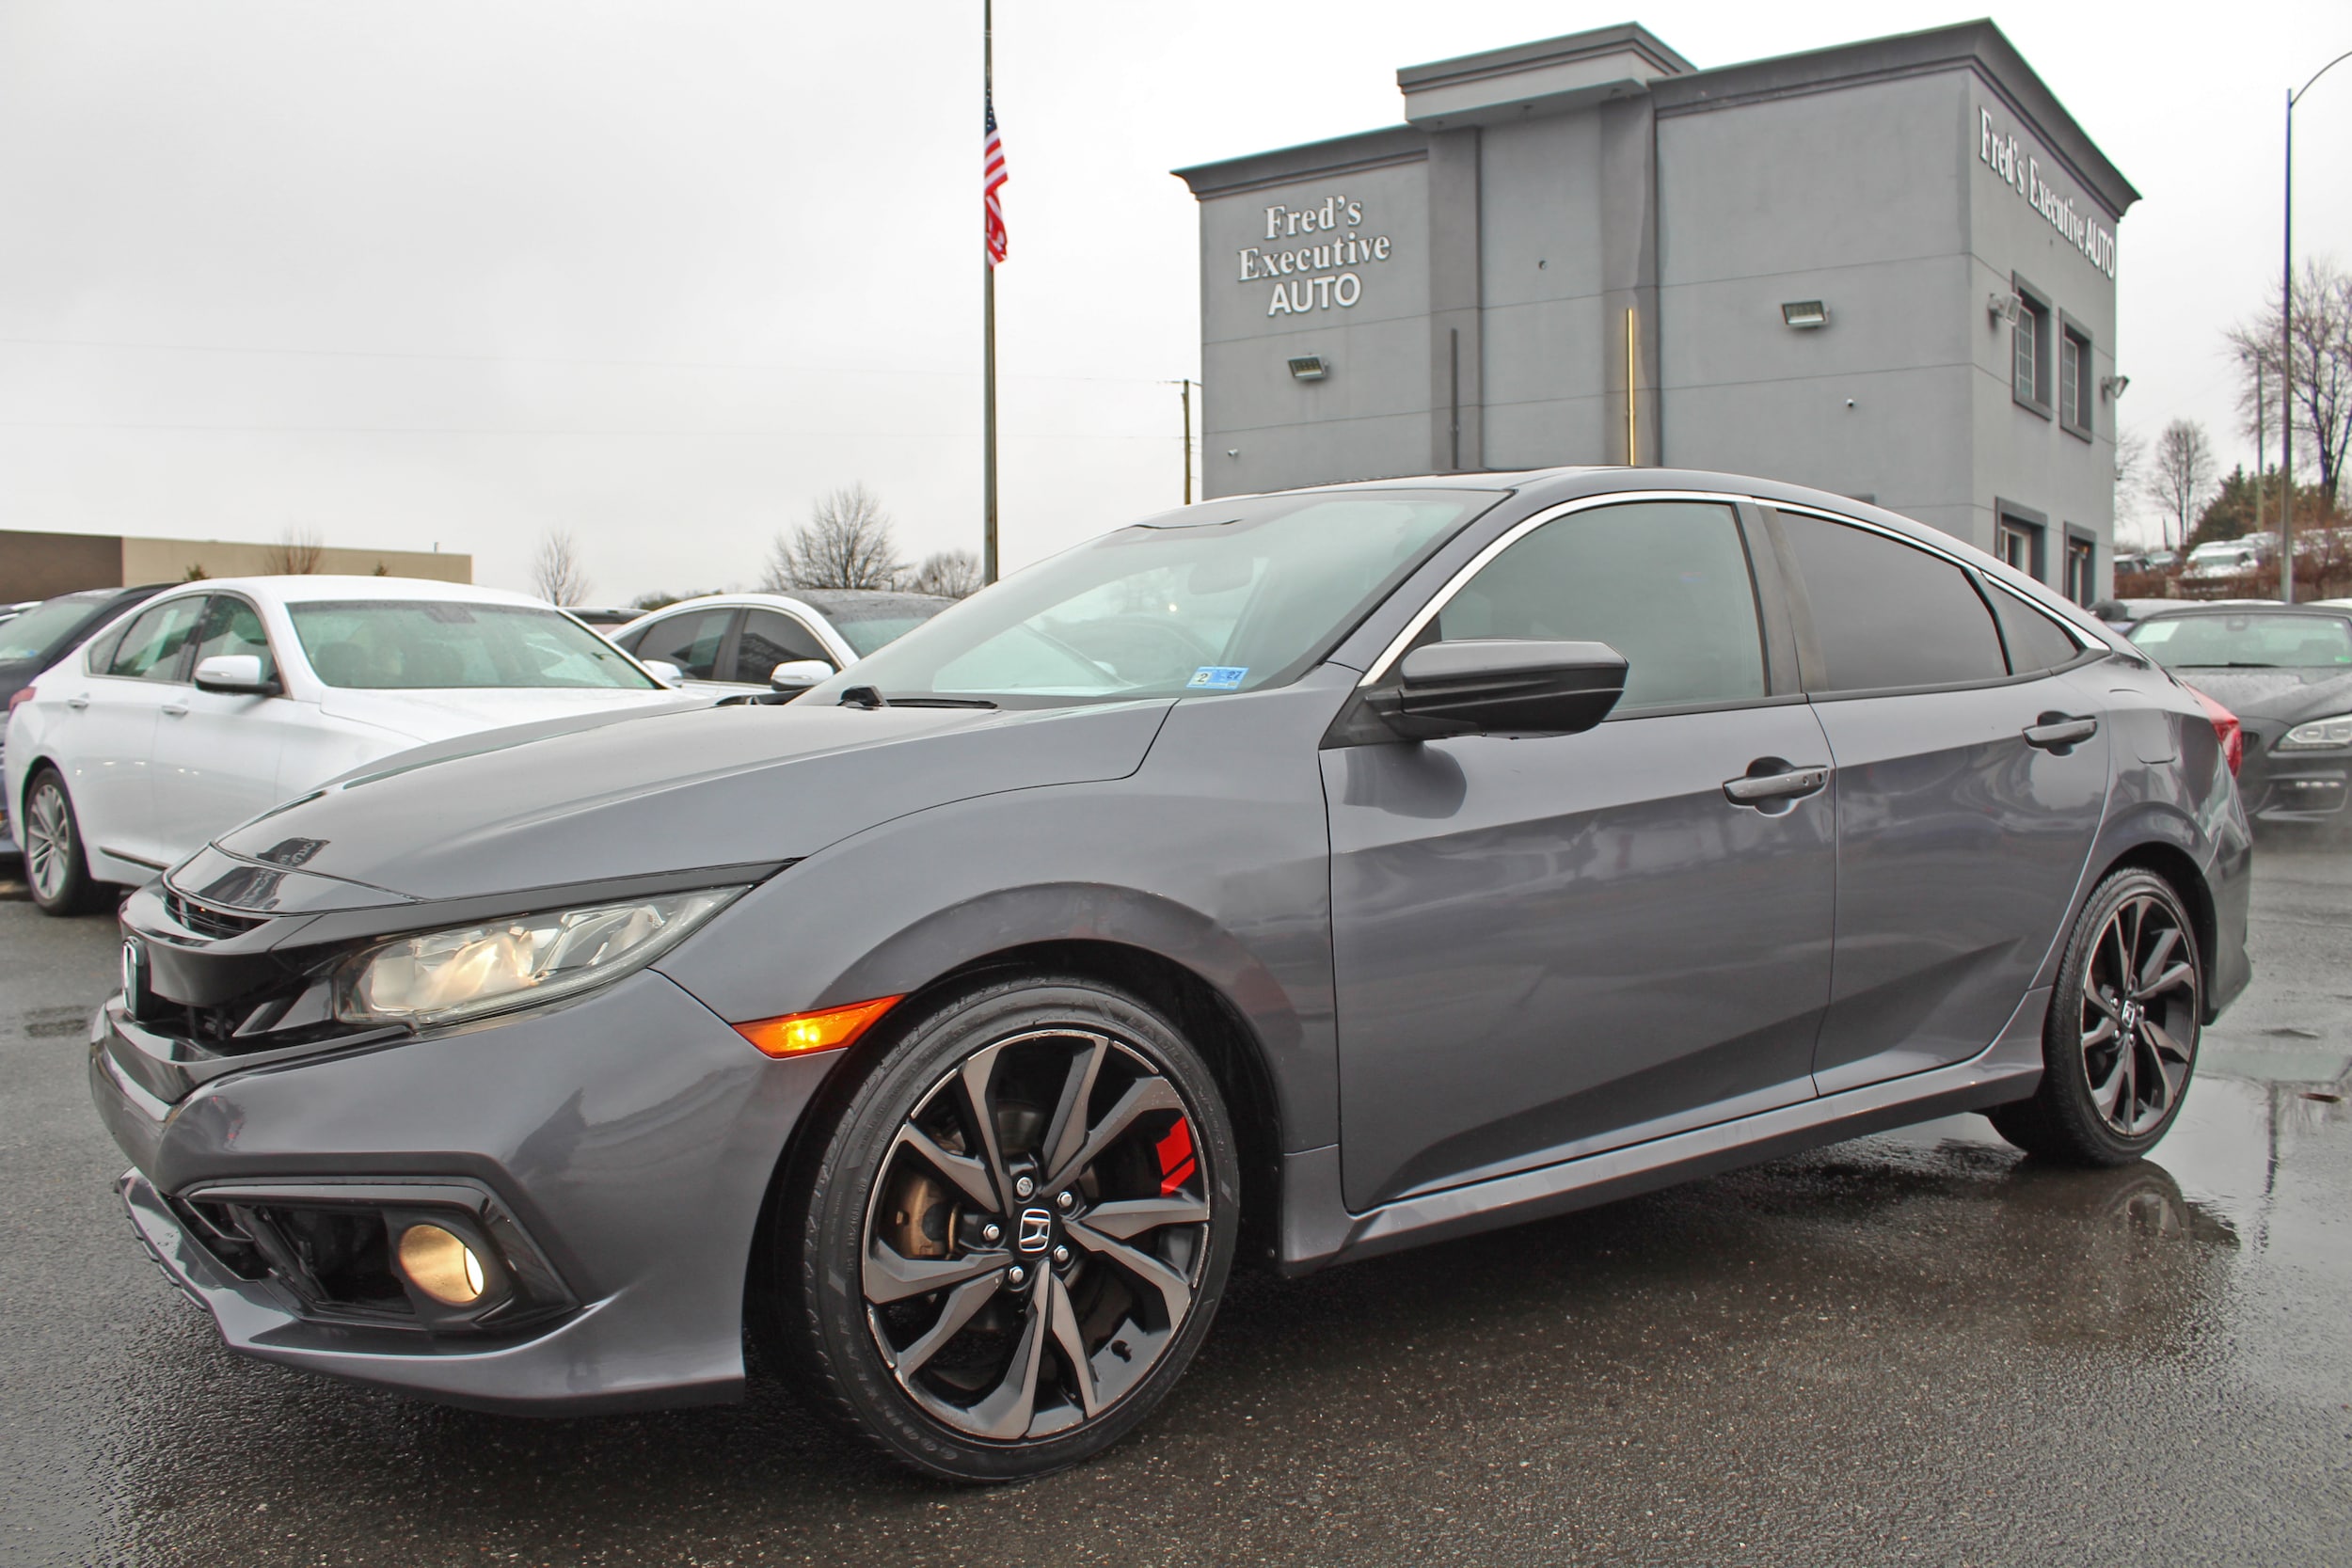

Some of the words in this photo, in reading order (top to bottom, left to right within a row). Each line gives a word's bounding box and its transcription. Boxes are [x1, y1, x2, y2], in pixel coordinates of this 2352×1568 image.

[1979, 105, 2024, 196] Fred's
[2028, 155, 2084, 251] Executive
[2085, 216, 2115, 279] AUTO
[1264, 195, 1362, 240] Fred's
[1238, 231, 1391, 281] Executive
[1267, 272, 1361, 317] AUTO
[1198, 673, 1208, 683] 2
[1227, 671, 1243, 679] 27
